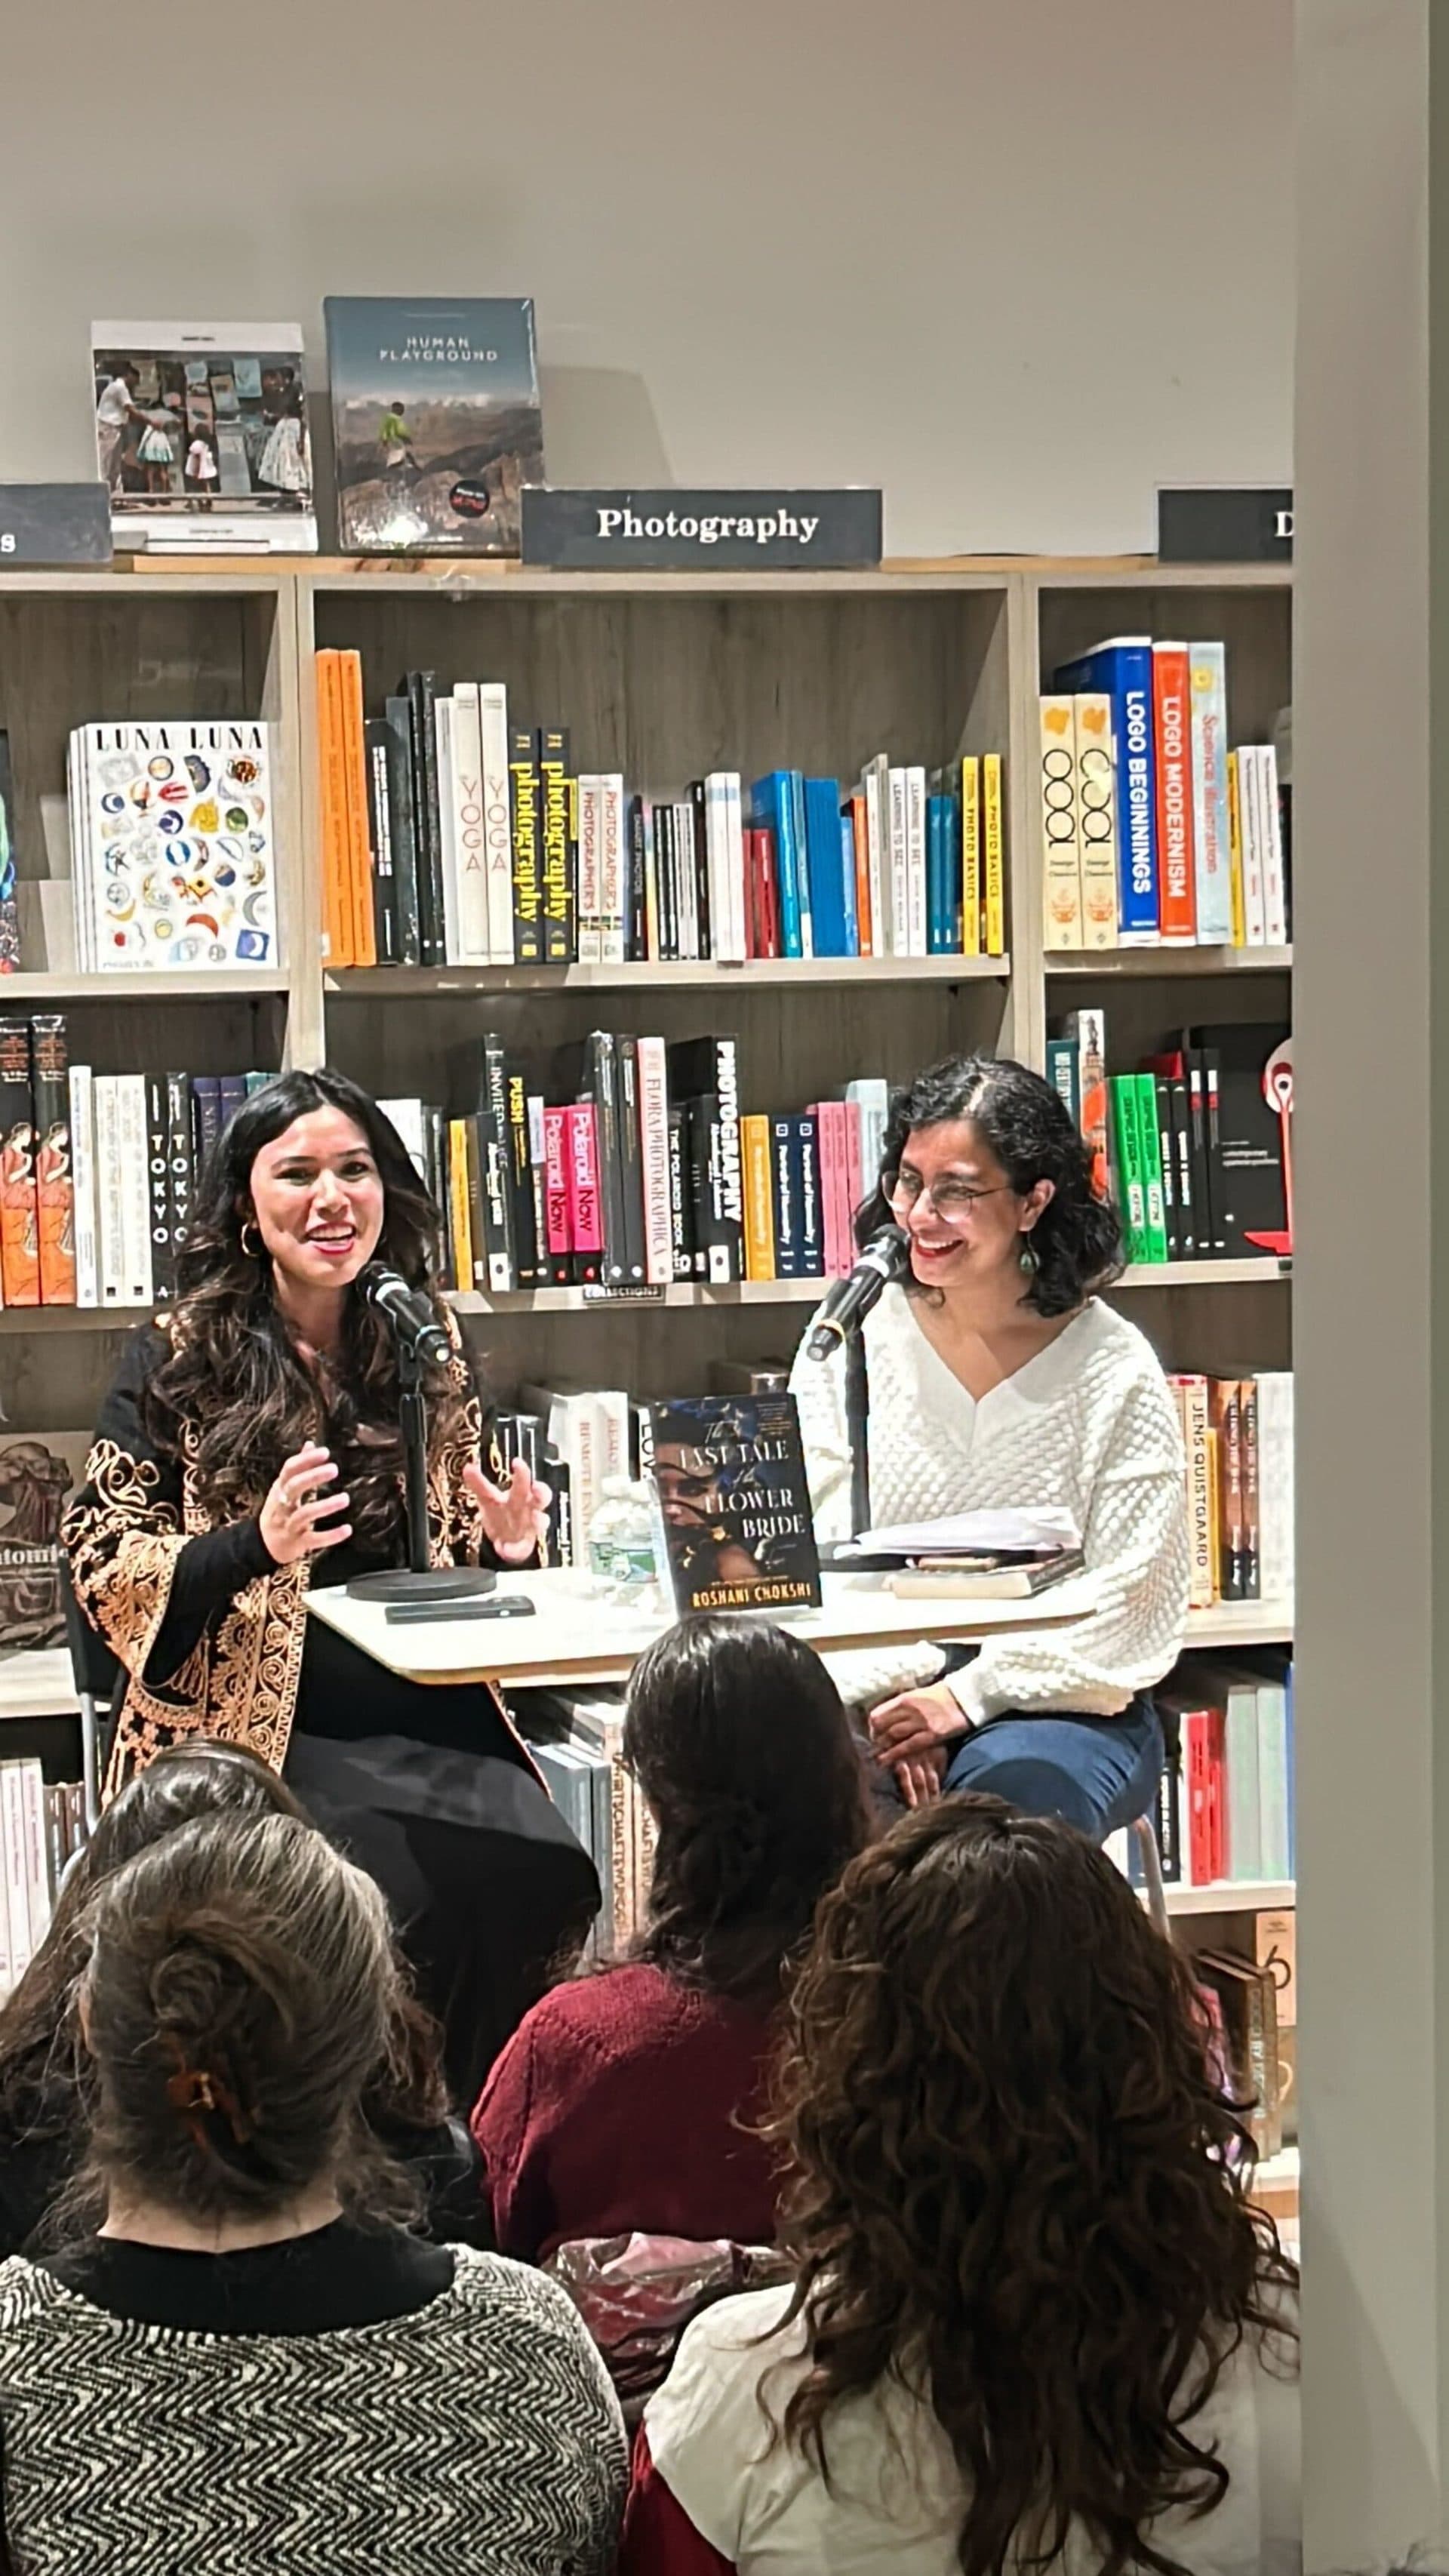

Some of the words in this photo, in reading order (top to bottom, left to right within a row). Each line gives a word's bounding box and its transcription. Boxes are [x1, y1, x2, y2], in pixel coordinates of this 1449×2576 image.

[380, 349, 498, 362] PLAYGROUND
[407, 337, 469, 349] HUMAN
[597, 509, 819, 543] Photography
[97, 728, 171, 751] LUNA
[190, 726, 263, 749] LUNA
[1126, 691, 1147, 753] LOGO
[1162, 695, 1182, 756] LOGO
[459, 775, 481, 873] YOGA
[487, 774, 508, 873] YOGA
[509, 762, 543, 923] photography
[541, 761, 573, 922] photography
[967, 807, 976, 853] PHOTO
[989, 805, 998, 850] PHOTO
[1128, 757, 1152, 894] BEGINNINGS
[1164, 762, 1186, 898] MODERNISM
[967, 857, 976, 900] BASICS
[989, 854, 998, 899] BASICS
[509, 1077, 525, 1124] PUSH
[646, 1078, 663, 1127] FLORA
[546, 1114, 564, 1190] Polaroid
[574, 1111, 593, 1188] Polaroid
[717, 1041, 743, 1223] PHOTOGRAPHY
[150, 1134, 168, 1244] TOKYO
[549, 1191, 566, 1233] Now
[578, 1189, 594, 1232] Now
[648, 1129, 669, 1257] PHOTOGRAPHICA
[1192, 1403, 1205, 1448] JENS
[680, 1445, 729, 1470] LAST
[737, 1439, 789, 1463] TALE
[705, 1488, 794, 1515] FLOWER
[1192, 1454, 1209, 1568] QUISTGAARD
[742, 1513, 806, 1539] BRIDE
[692, 1587, 750, 1608] ROSHANI
[754, 1582, 812, 1602] CHOKSHI
